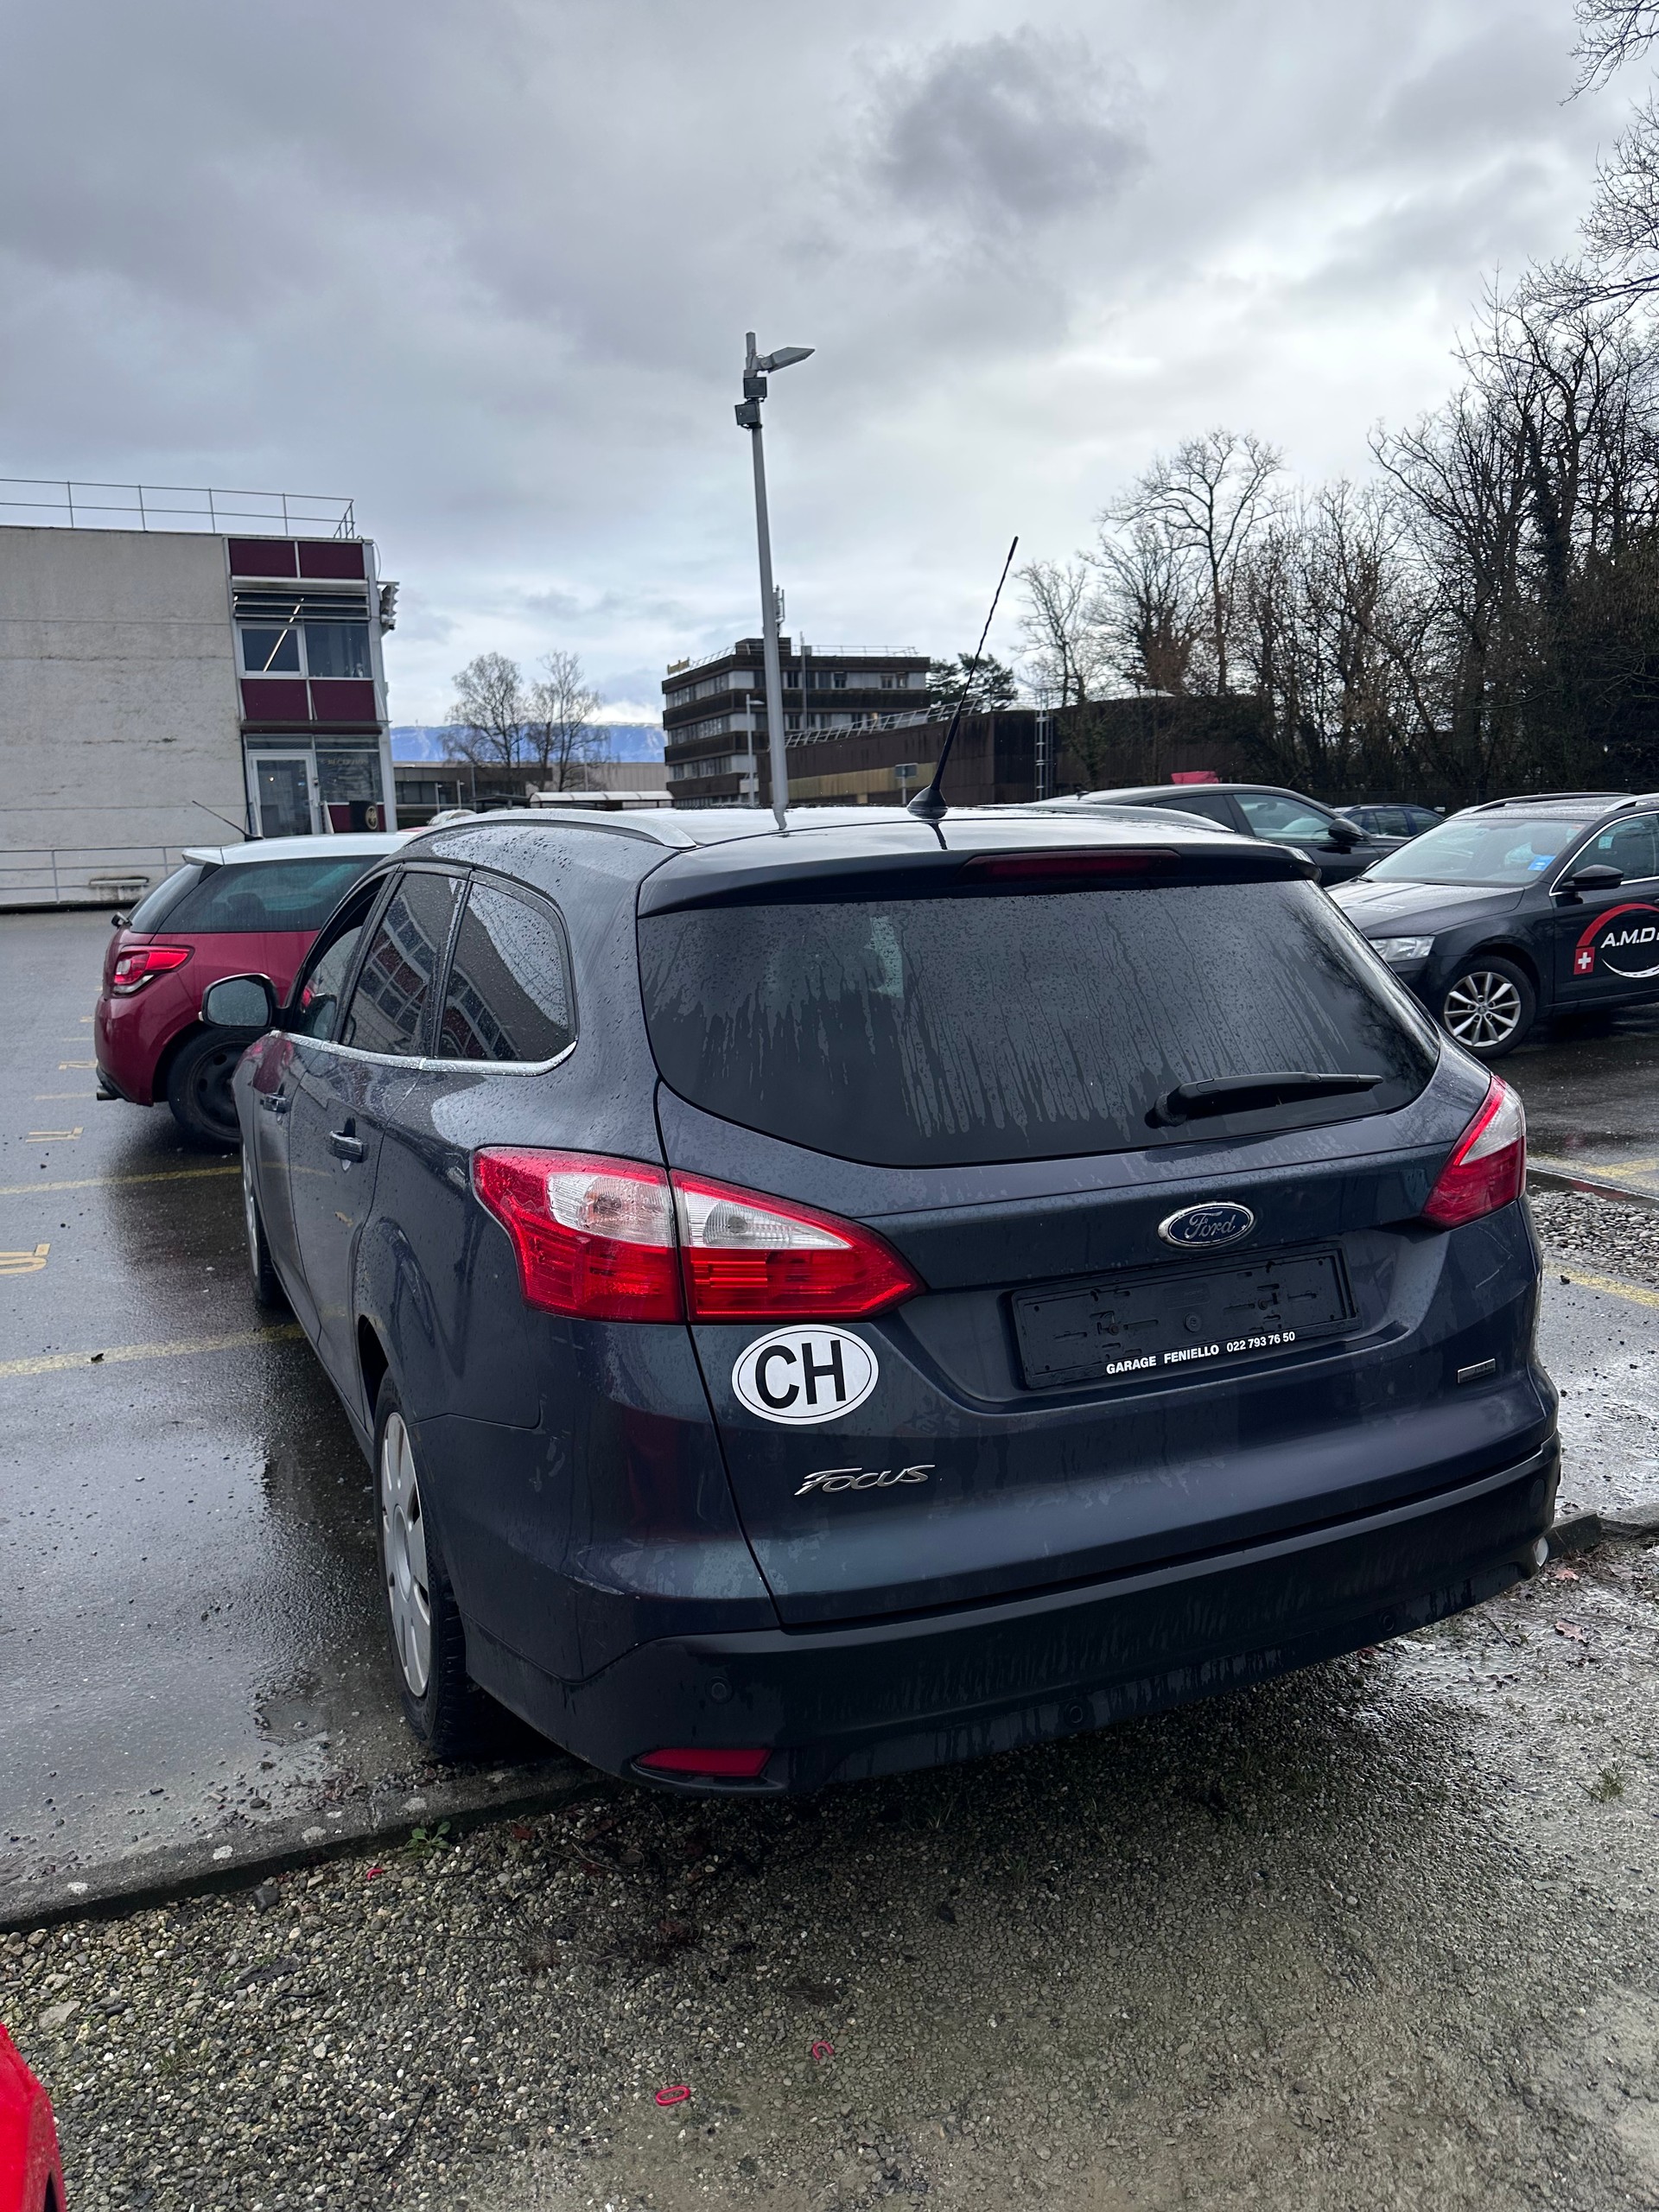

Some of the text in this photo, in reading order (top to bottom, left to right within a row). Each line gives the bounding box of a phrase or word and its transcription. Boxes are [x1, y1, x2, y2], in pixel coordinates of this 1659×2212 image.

[1185, 1211, 1236, 1239] Ford
[755, 1339, 847, 1409] CH
[1106, 1332, 1295, 1374] GARAGE FENIELLO 022 793 76 50
